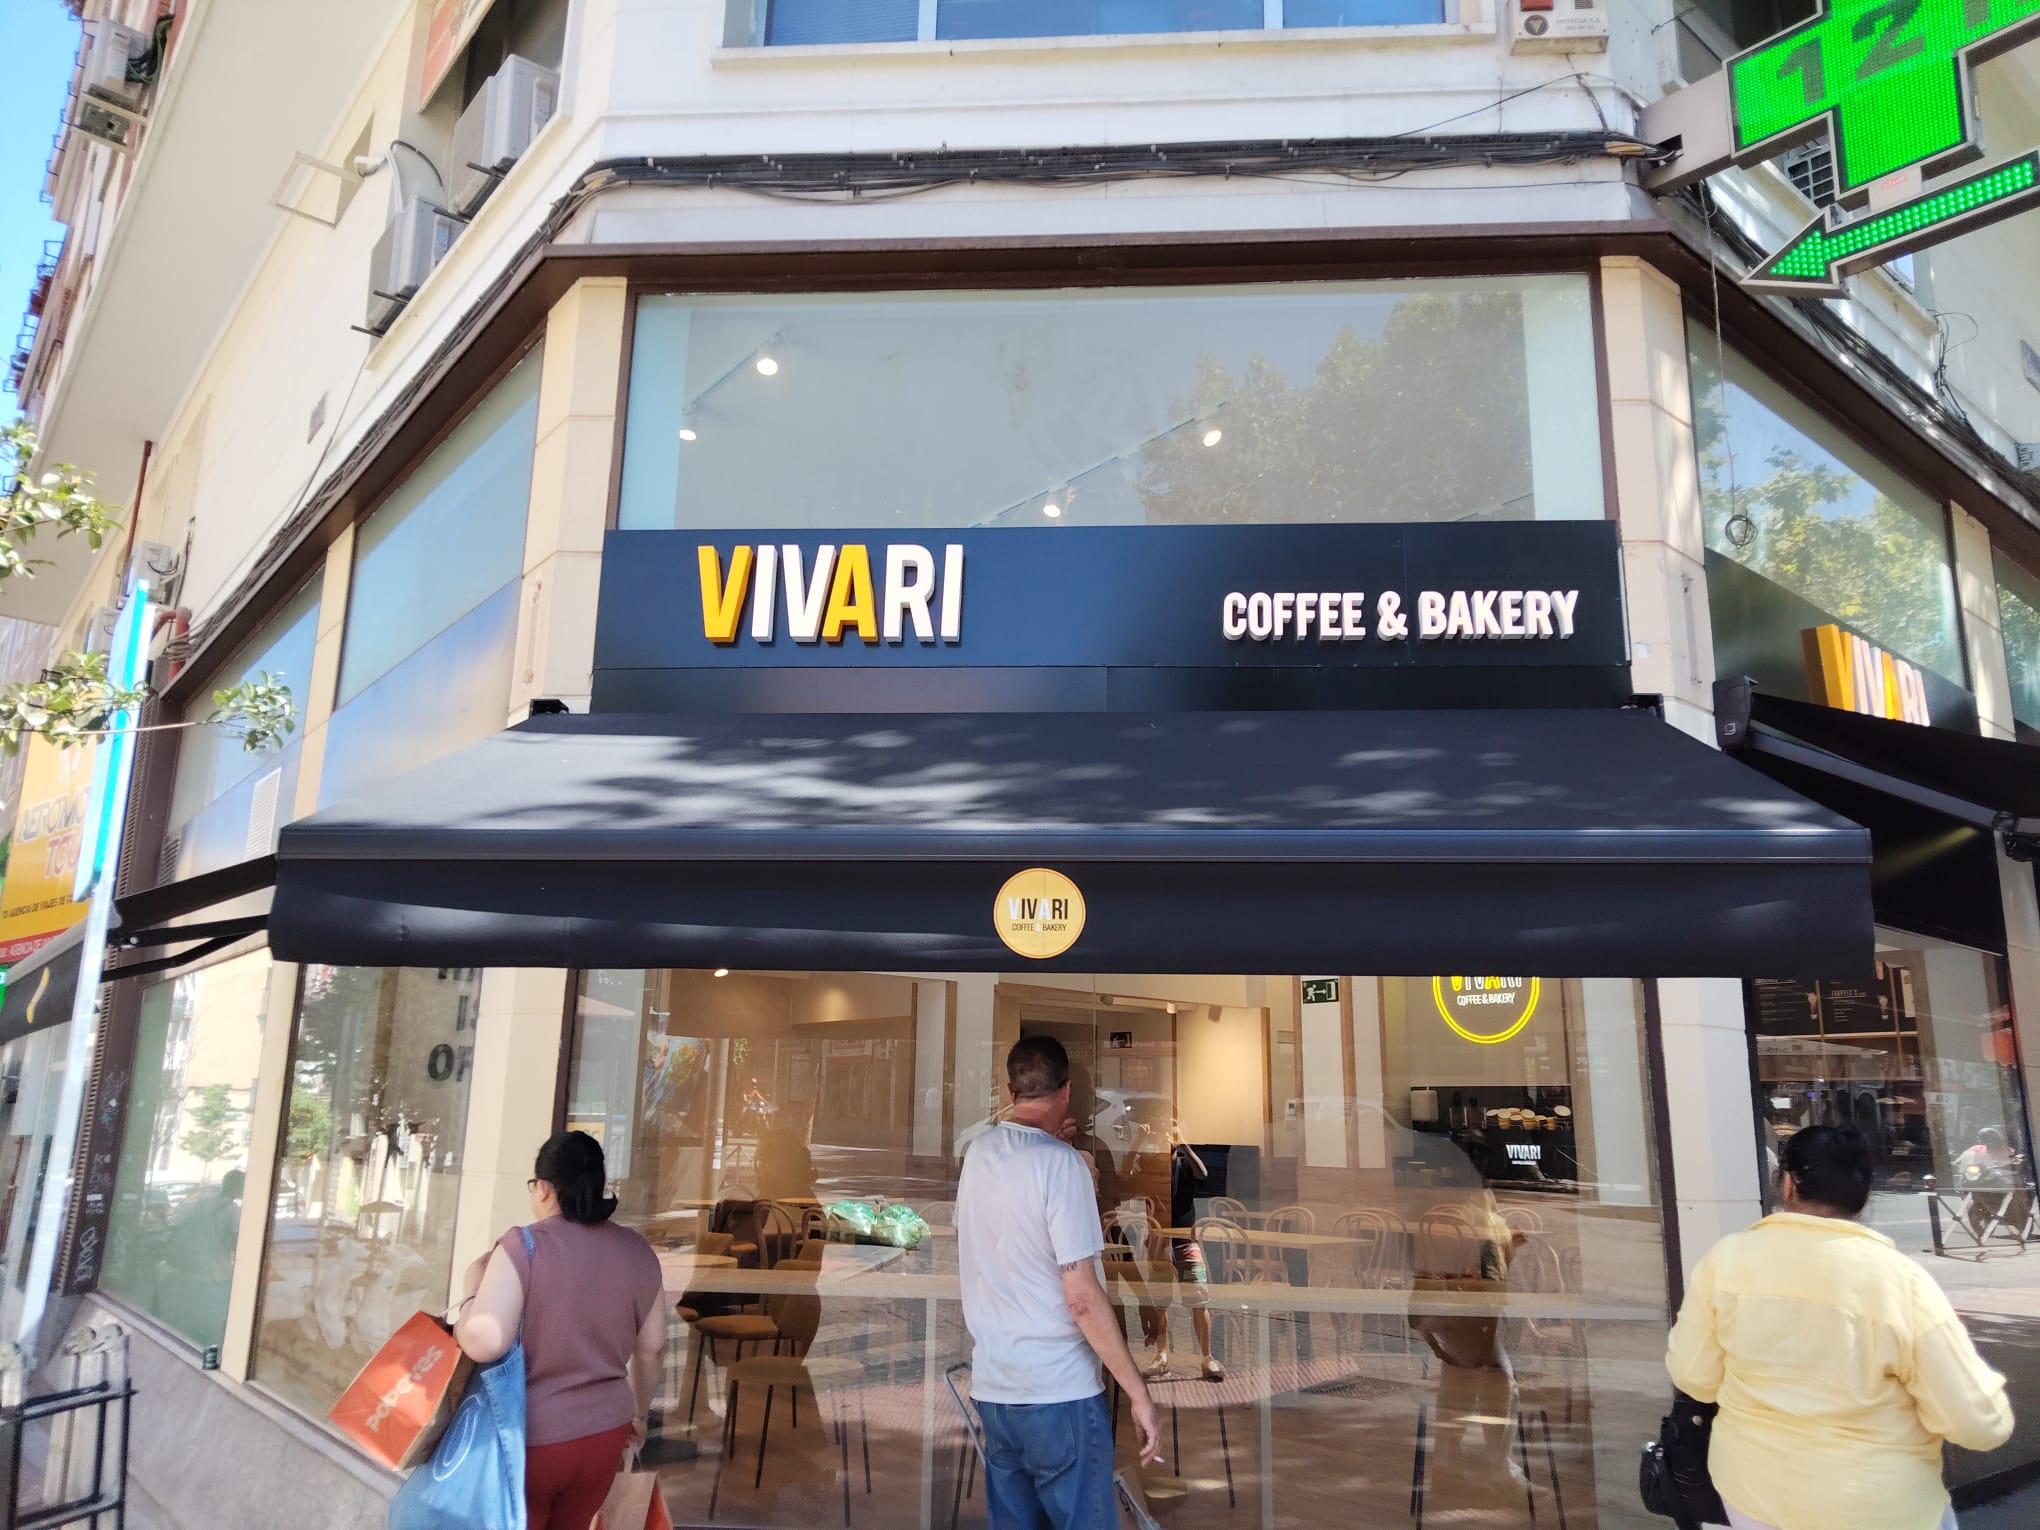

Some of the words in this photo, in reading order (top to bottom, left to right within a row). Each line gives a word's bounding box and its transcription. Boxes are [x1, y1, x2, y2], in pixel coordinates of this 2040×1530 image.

[697, 544, 964, 643] VIVARI
[1223, 591, 1365, 641] COFFEE
[1377, 590, 1408, 641] &
[1418, 590, 1579, 640] BAKERY
[1803, 623, 1930, 727] VIVARI
[1008, 897, 1069, 920] VIVARI
[1012, 923, 1034, 931] COFFEE
[1042, 923, 1067, 931] BAKERY
[1505, 1144, 1541, 1160] VIVARI
